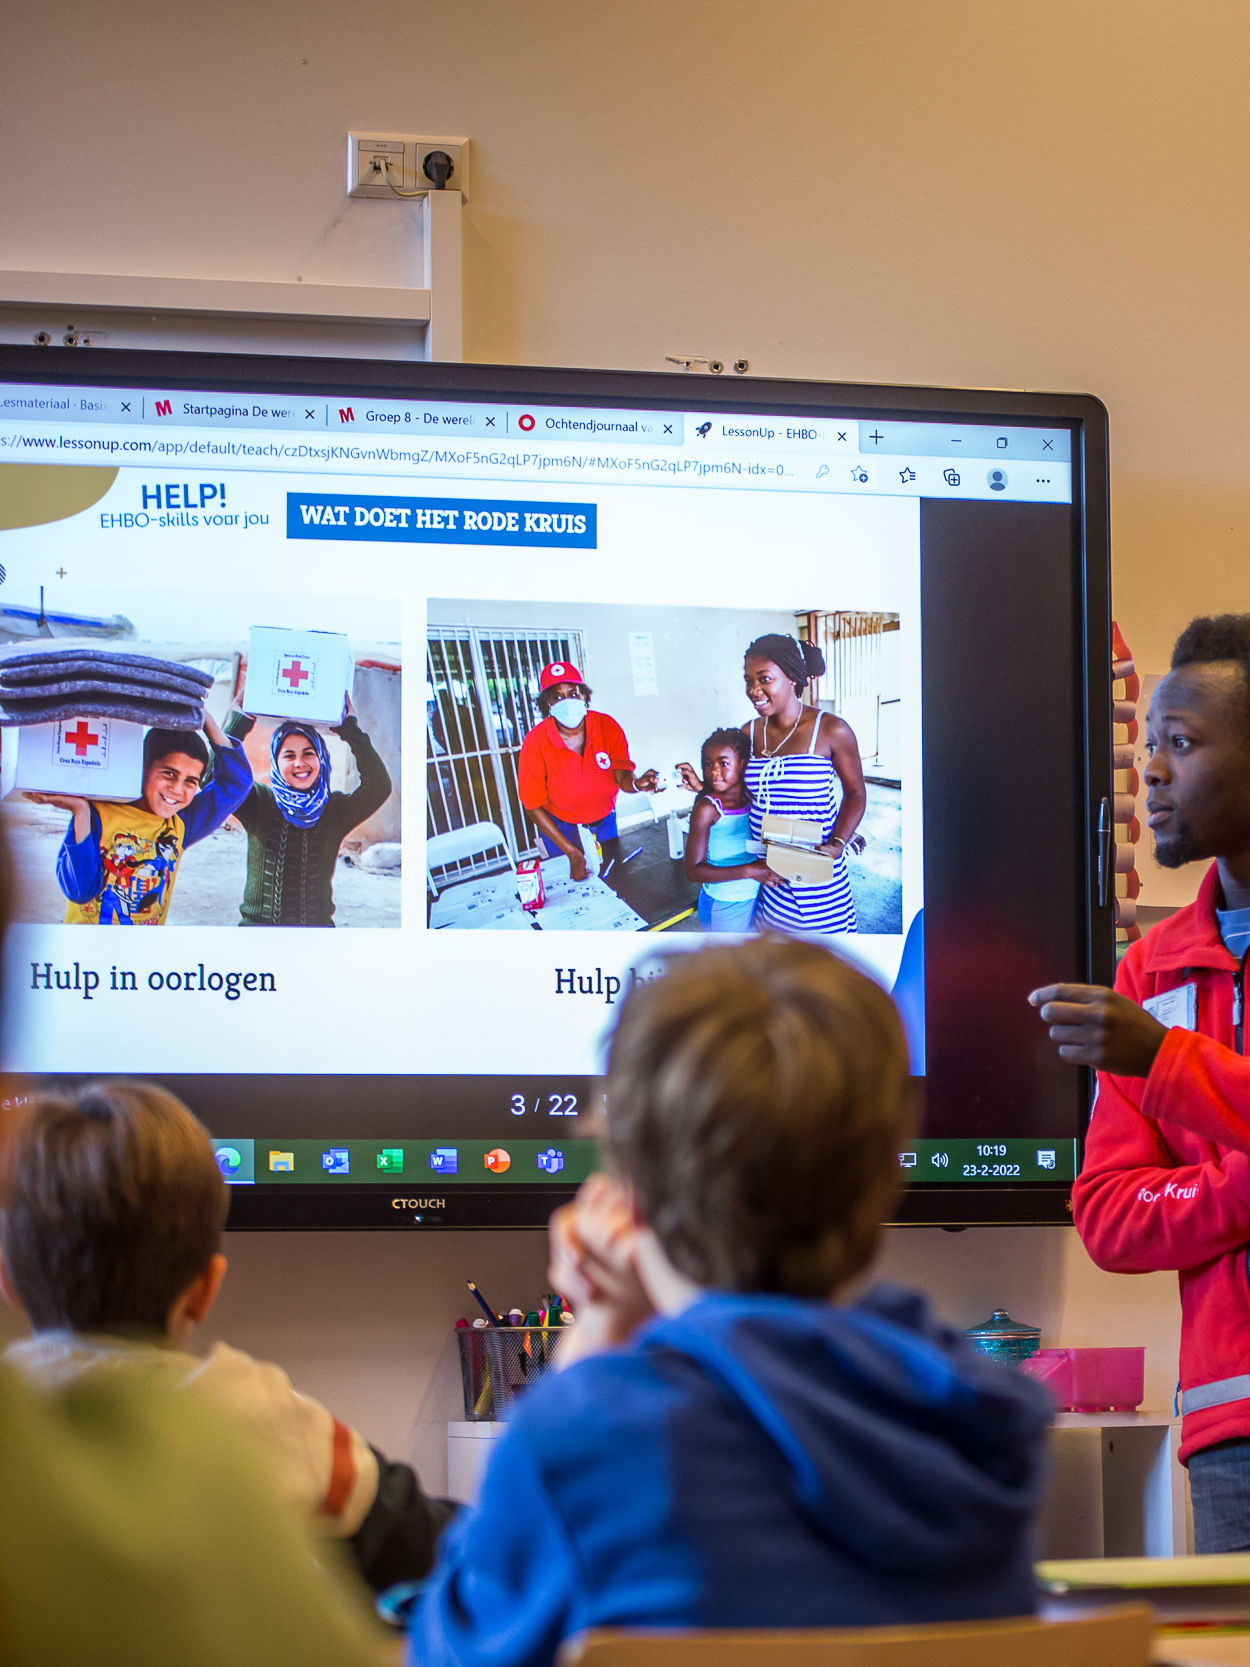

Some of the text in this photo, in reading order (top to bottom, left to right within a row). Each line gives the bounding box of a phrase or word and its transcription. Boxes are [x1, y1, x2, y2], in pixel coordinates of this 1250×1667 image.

[183, 403, 249, 419] Startpagina
[252, 406, 269, 417] De
[366, 411, 401, 425] Groep
[404, 412, 412, 423] 8
[423, 413, 440, 425] De
[545, 418, 638, 434] Ochtendjournaal
[722, 426, 775, 441] LessonUp
[141, 483, 227, 510] HELP!
[100, 511, 199, 529] EHBO-skills
[243, 510, 269, 530] jou
[299, 504, 587, 535] WAT DOET HET RODE KRUIS
[30, 962, 277, 1000] Hulp in oorlogen
[554, 967, 621, 1004] Hulp
[510, 1094, 526, 1116] 3
[548, 1093, 579, 1116] 22
[976, 1144, 1007, 1157] 10:19
[962, 1164, 1020, 1177] 23-2-2022
[391, 1198, 446, 1210] CTOUCH
